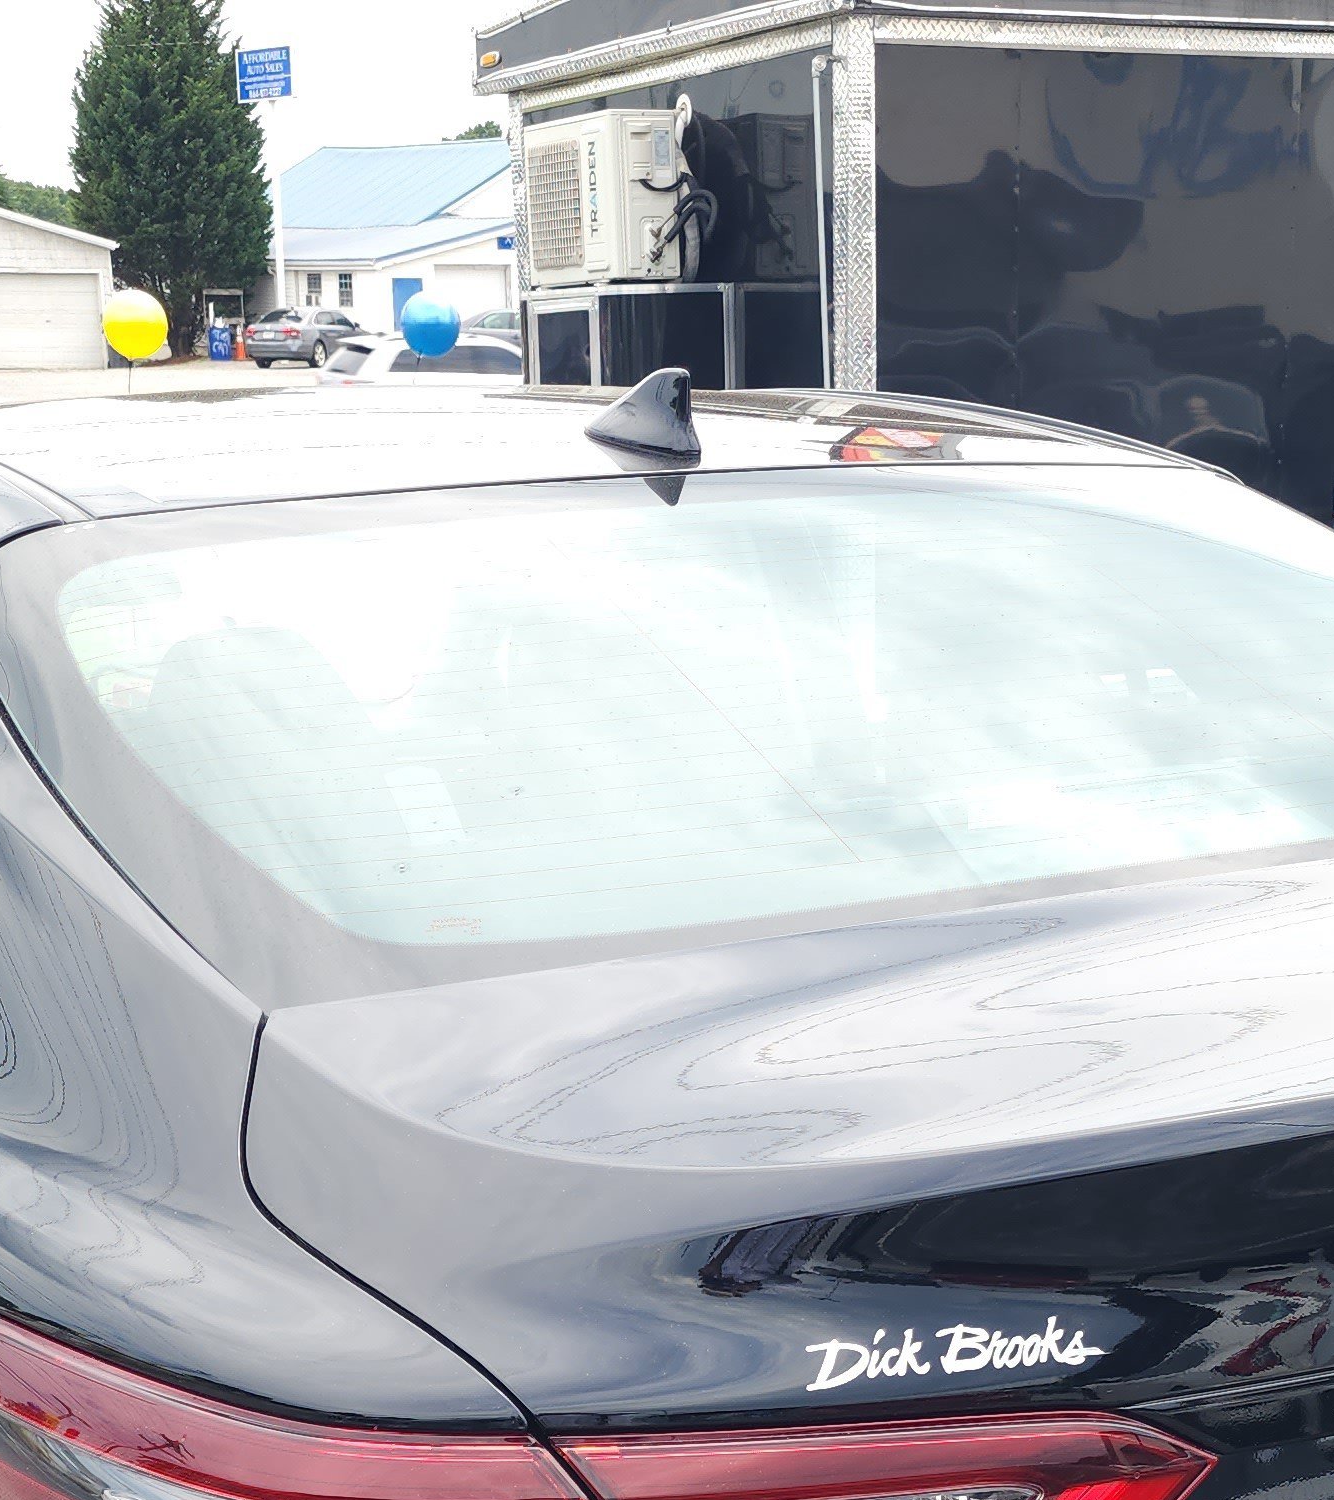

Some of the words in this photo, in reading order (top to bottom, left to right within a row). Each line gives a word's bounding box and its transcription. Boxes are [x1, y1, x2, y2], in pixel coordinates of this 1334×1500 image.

[242, 50, 287, 64] AFFORDABLE
[246, 63, 264, 75] AUTO
[265, 61, 284, 73] SALES
[587, 140, 599, 237] TRAIDEN
[805, 1328, 931, 1392] Dick
[935, 1315, 1111, 1375] Brooks
